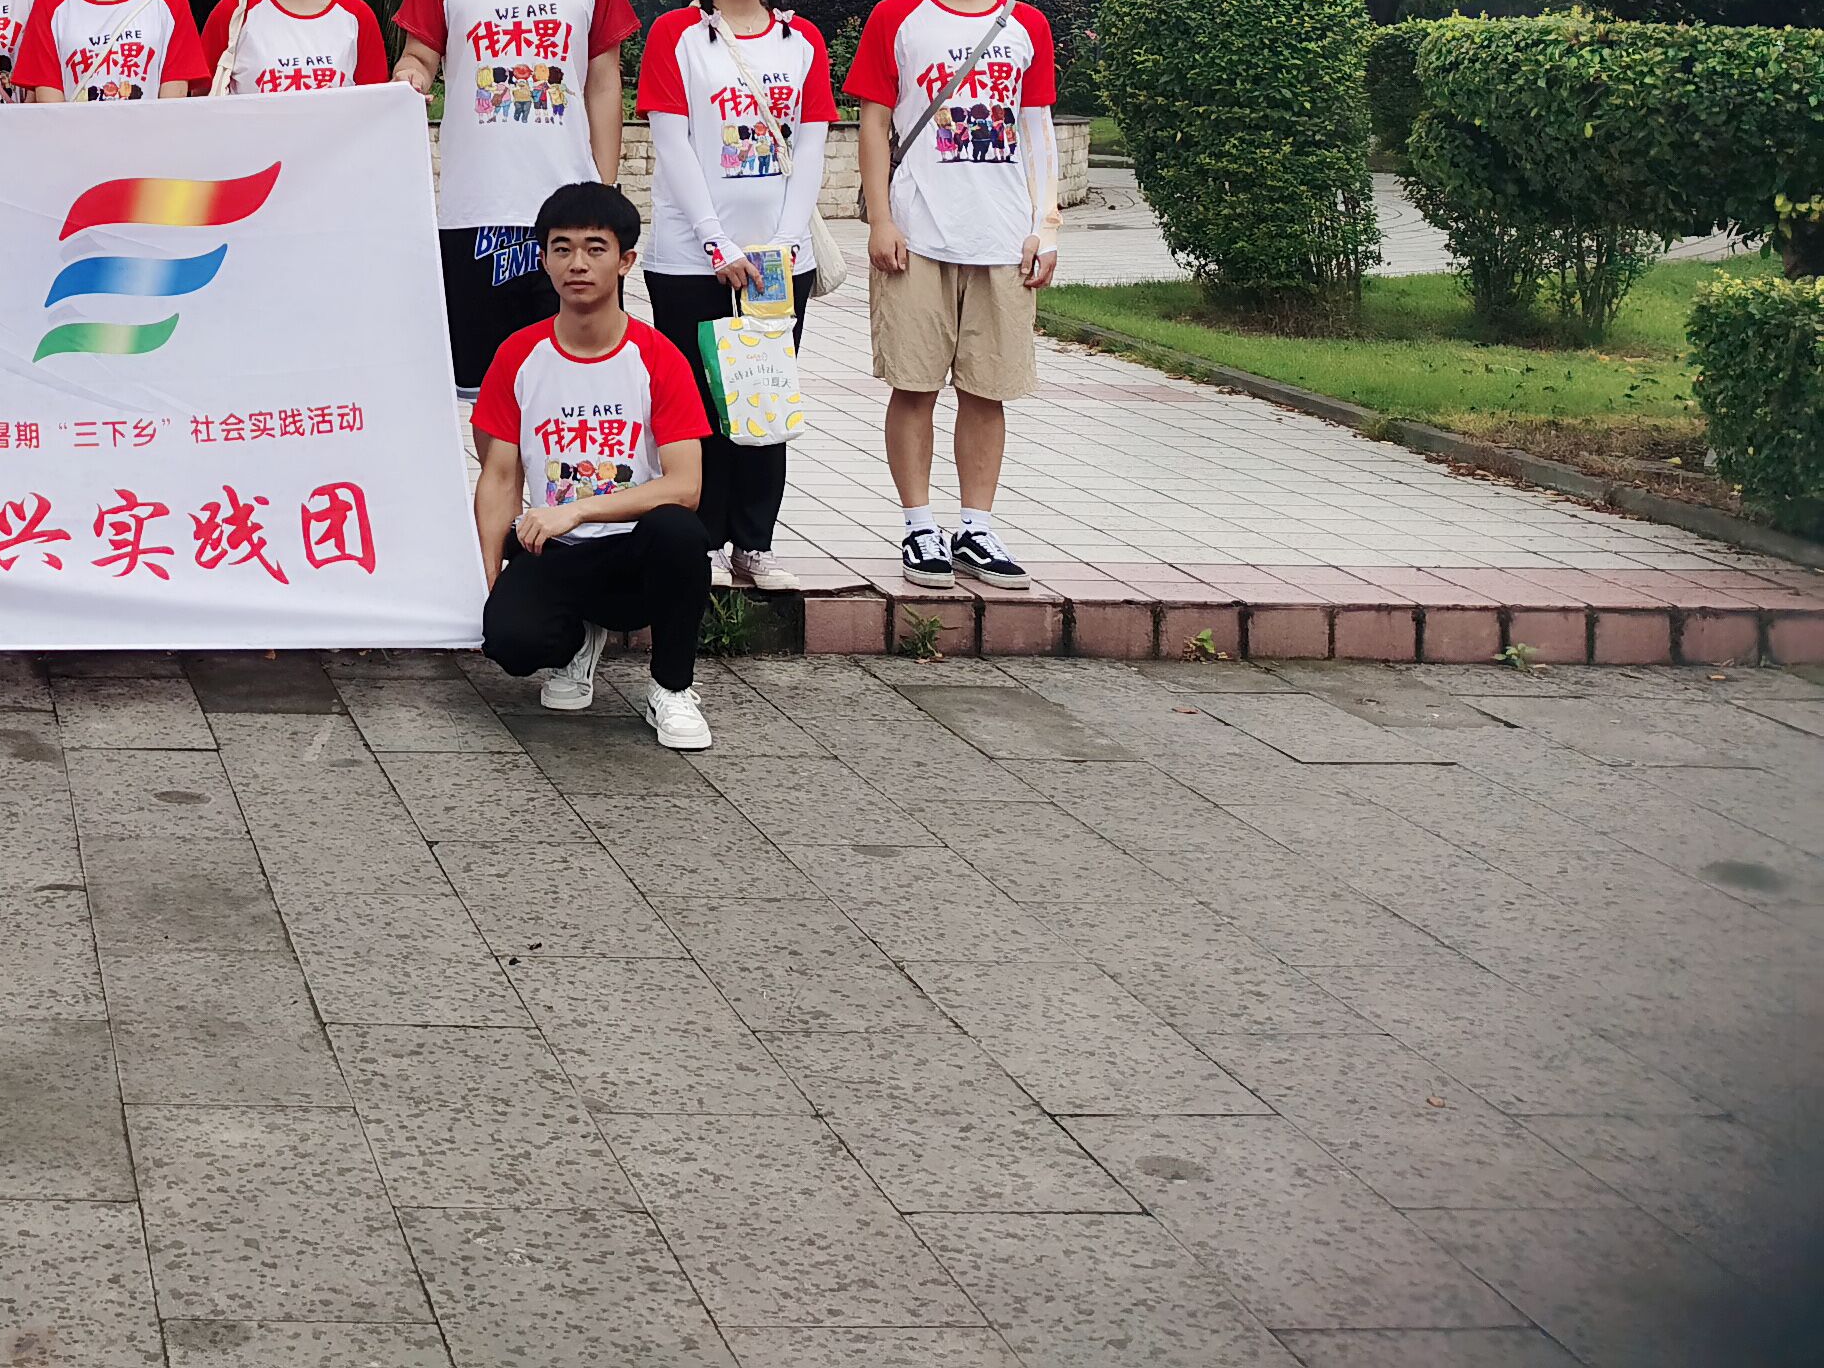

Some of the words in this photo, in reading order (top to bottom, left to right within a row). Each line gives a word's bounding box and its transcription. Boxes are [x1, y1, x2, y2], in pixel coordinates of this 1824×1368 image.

[495, 6, 520, 20] WE
[526, 2, 558, 18] ARE
[466, 18, 573, 62] 伐木累!
[278, 58, 301, 68] WE
[306, 55, 333, 67] ARE
[762, 72, 791, 83] ARE
[561, 405, 586, 418] WE
[592, 403, 624, 417] ARE
[534, 417, 643, 460] 伐木累!
